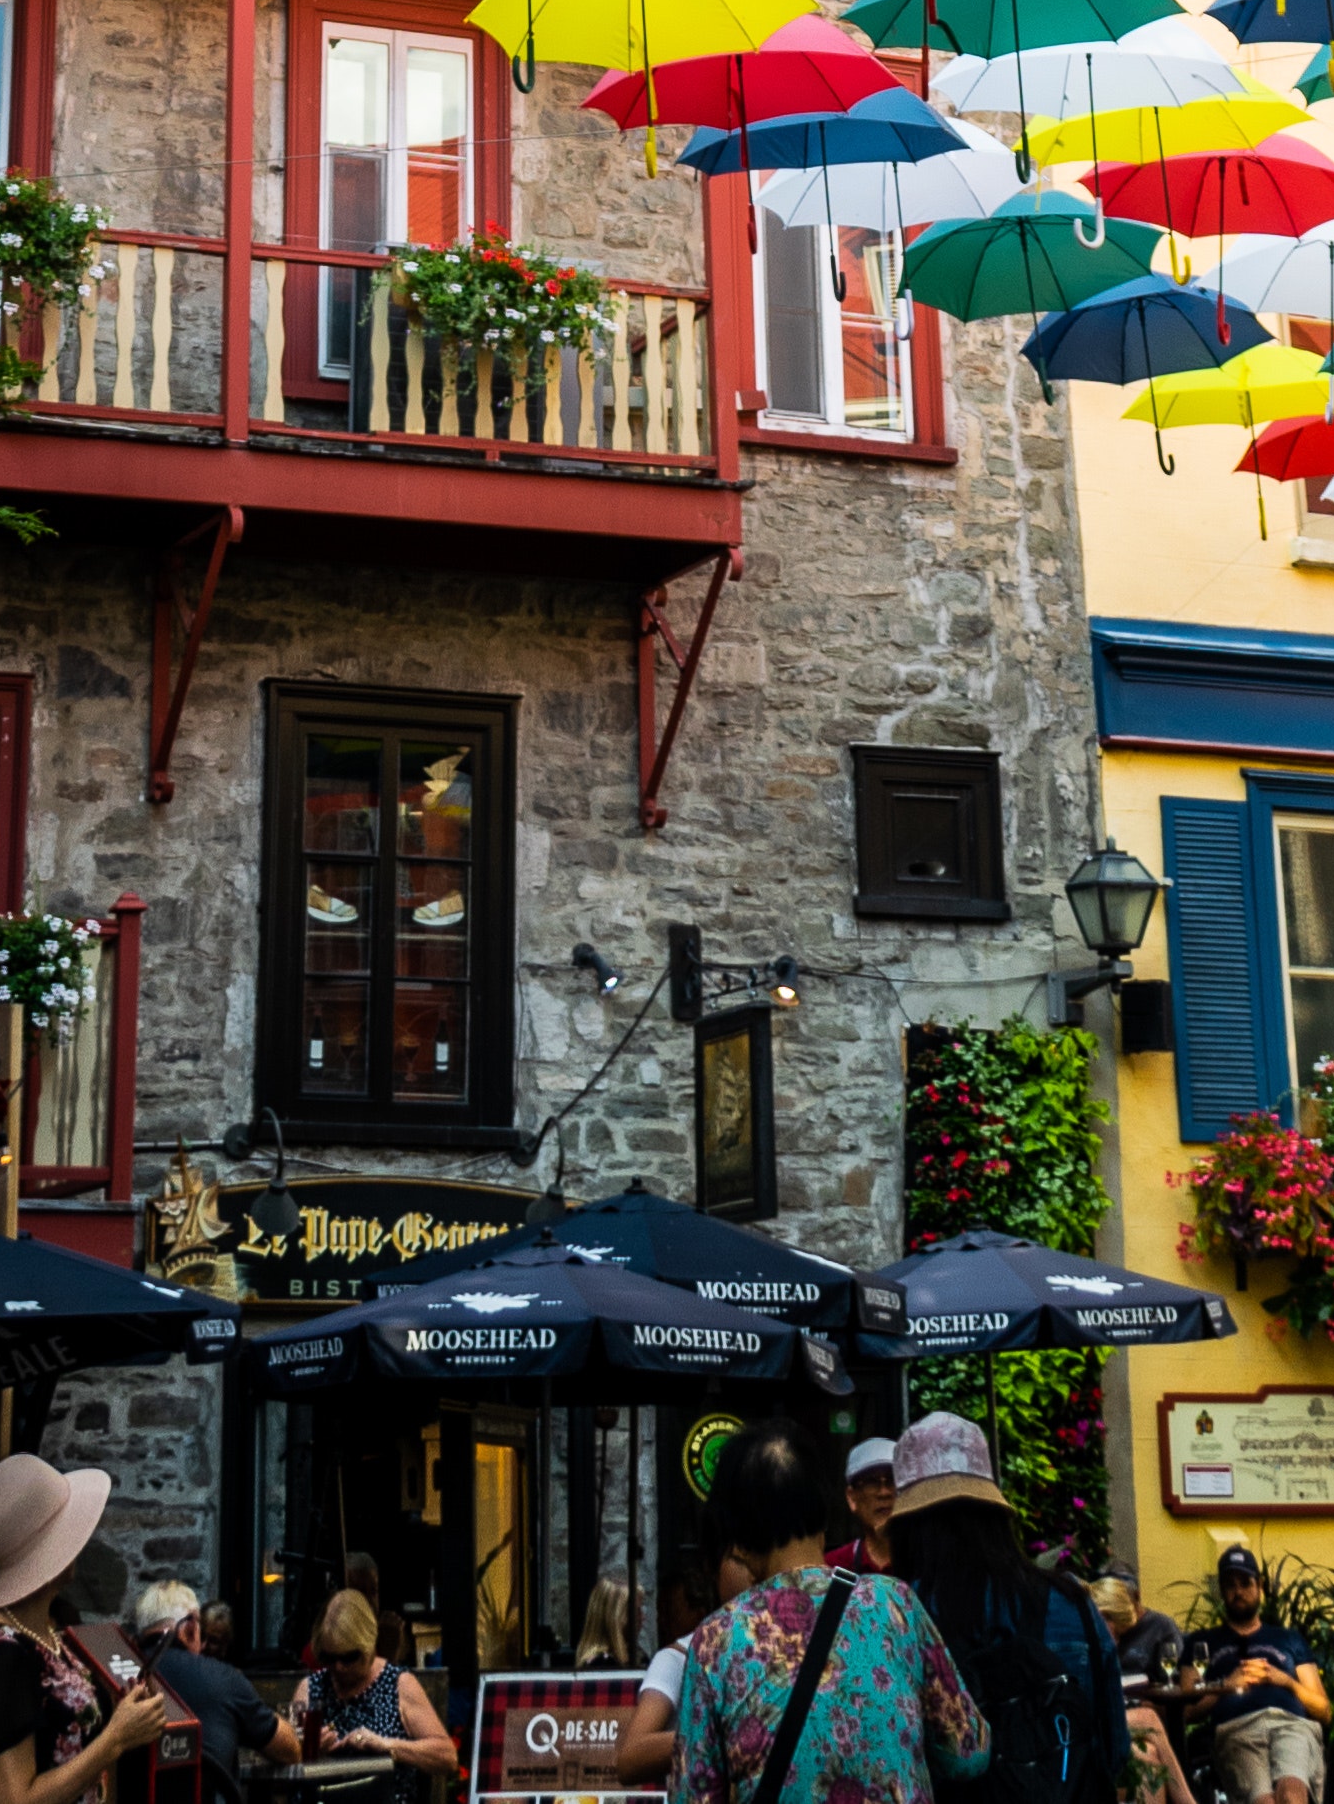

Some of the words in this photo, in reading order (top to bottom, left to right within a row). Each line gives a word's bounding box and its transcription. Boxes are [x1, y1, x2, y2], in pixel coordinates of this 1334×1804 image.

[289, 1279, 363, 1296] BIST
[696, 1280, 821, 1303] MOOSEHEAD
[906, 1312, 1009, 1336] OOSEHEAD
[1075, 1305, 1178, 1327] MOOSEHEAD
[405, 1328, 557, 1352] MOOSEHEAD
[633, 1324, 762, 1354] MOOSEHEAD
[268, 1337, 344, 1366] MOOSEHEAD
